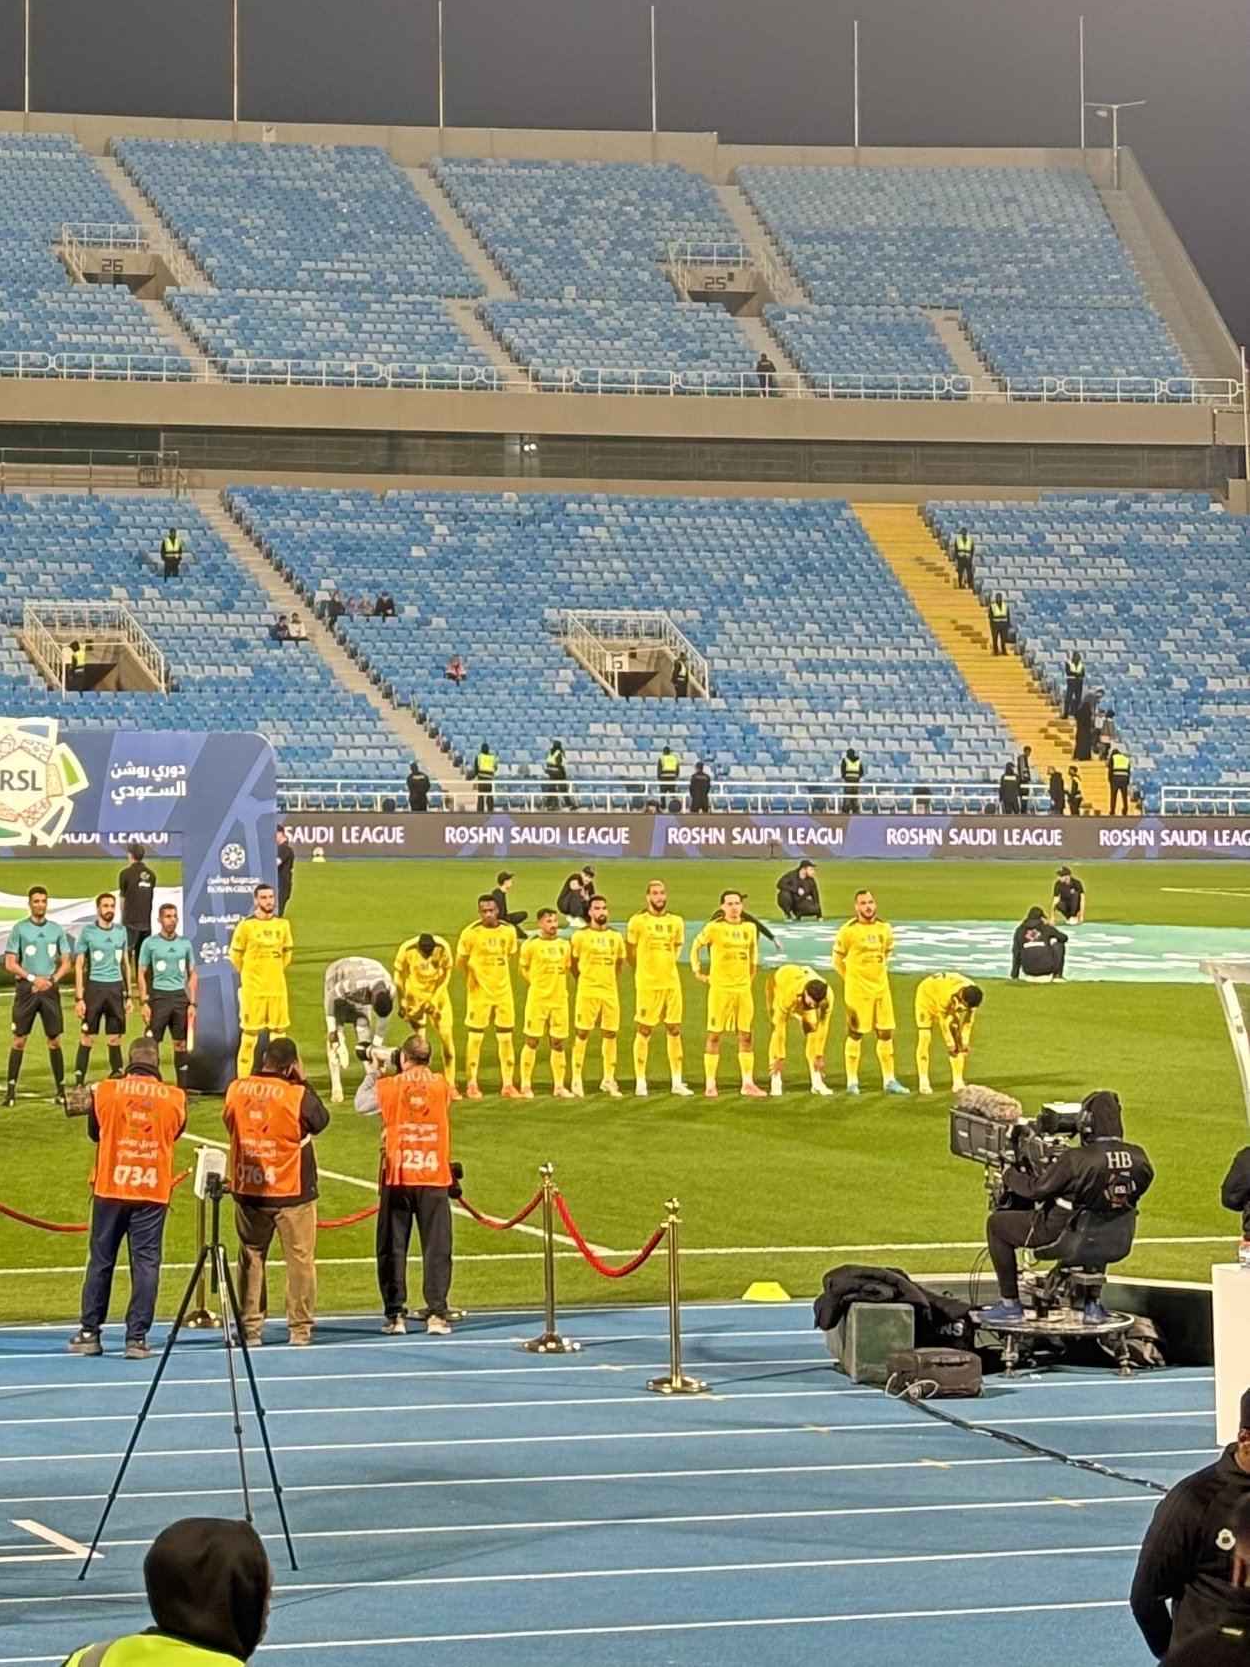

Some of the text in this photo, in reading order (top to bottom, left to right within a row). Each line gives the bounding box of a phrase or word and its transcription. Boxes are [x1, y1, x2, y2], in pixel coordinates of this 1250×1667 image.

[102, 258, 123, 272] 26
[705, 276, 726, 289] 25
[111, 761, 186, 781] دوري روشن
[0, 770, 42, 791] RSL
[111, 781, 186, 805] السعودي
[285, 827, 404, 844] SAUDI LEAGUE
[445, 827, 630, 844] ROSHN SAUDI LEAGUE
[667, 828, 725, 845] ROSHN
[886, 828, 1063, 846] ROSHN SAUDI LEAGUE
[1100, 830, 1155, 846] ROSHN
[1160, 830, 1207, 846] SAUDI
[116, 1080, 169, 1099] PHOTO
[238, 1081, 284, 1099] PHOTO
[1106, 1151, 1132, 1169] HB
